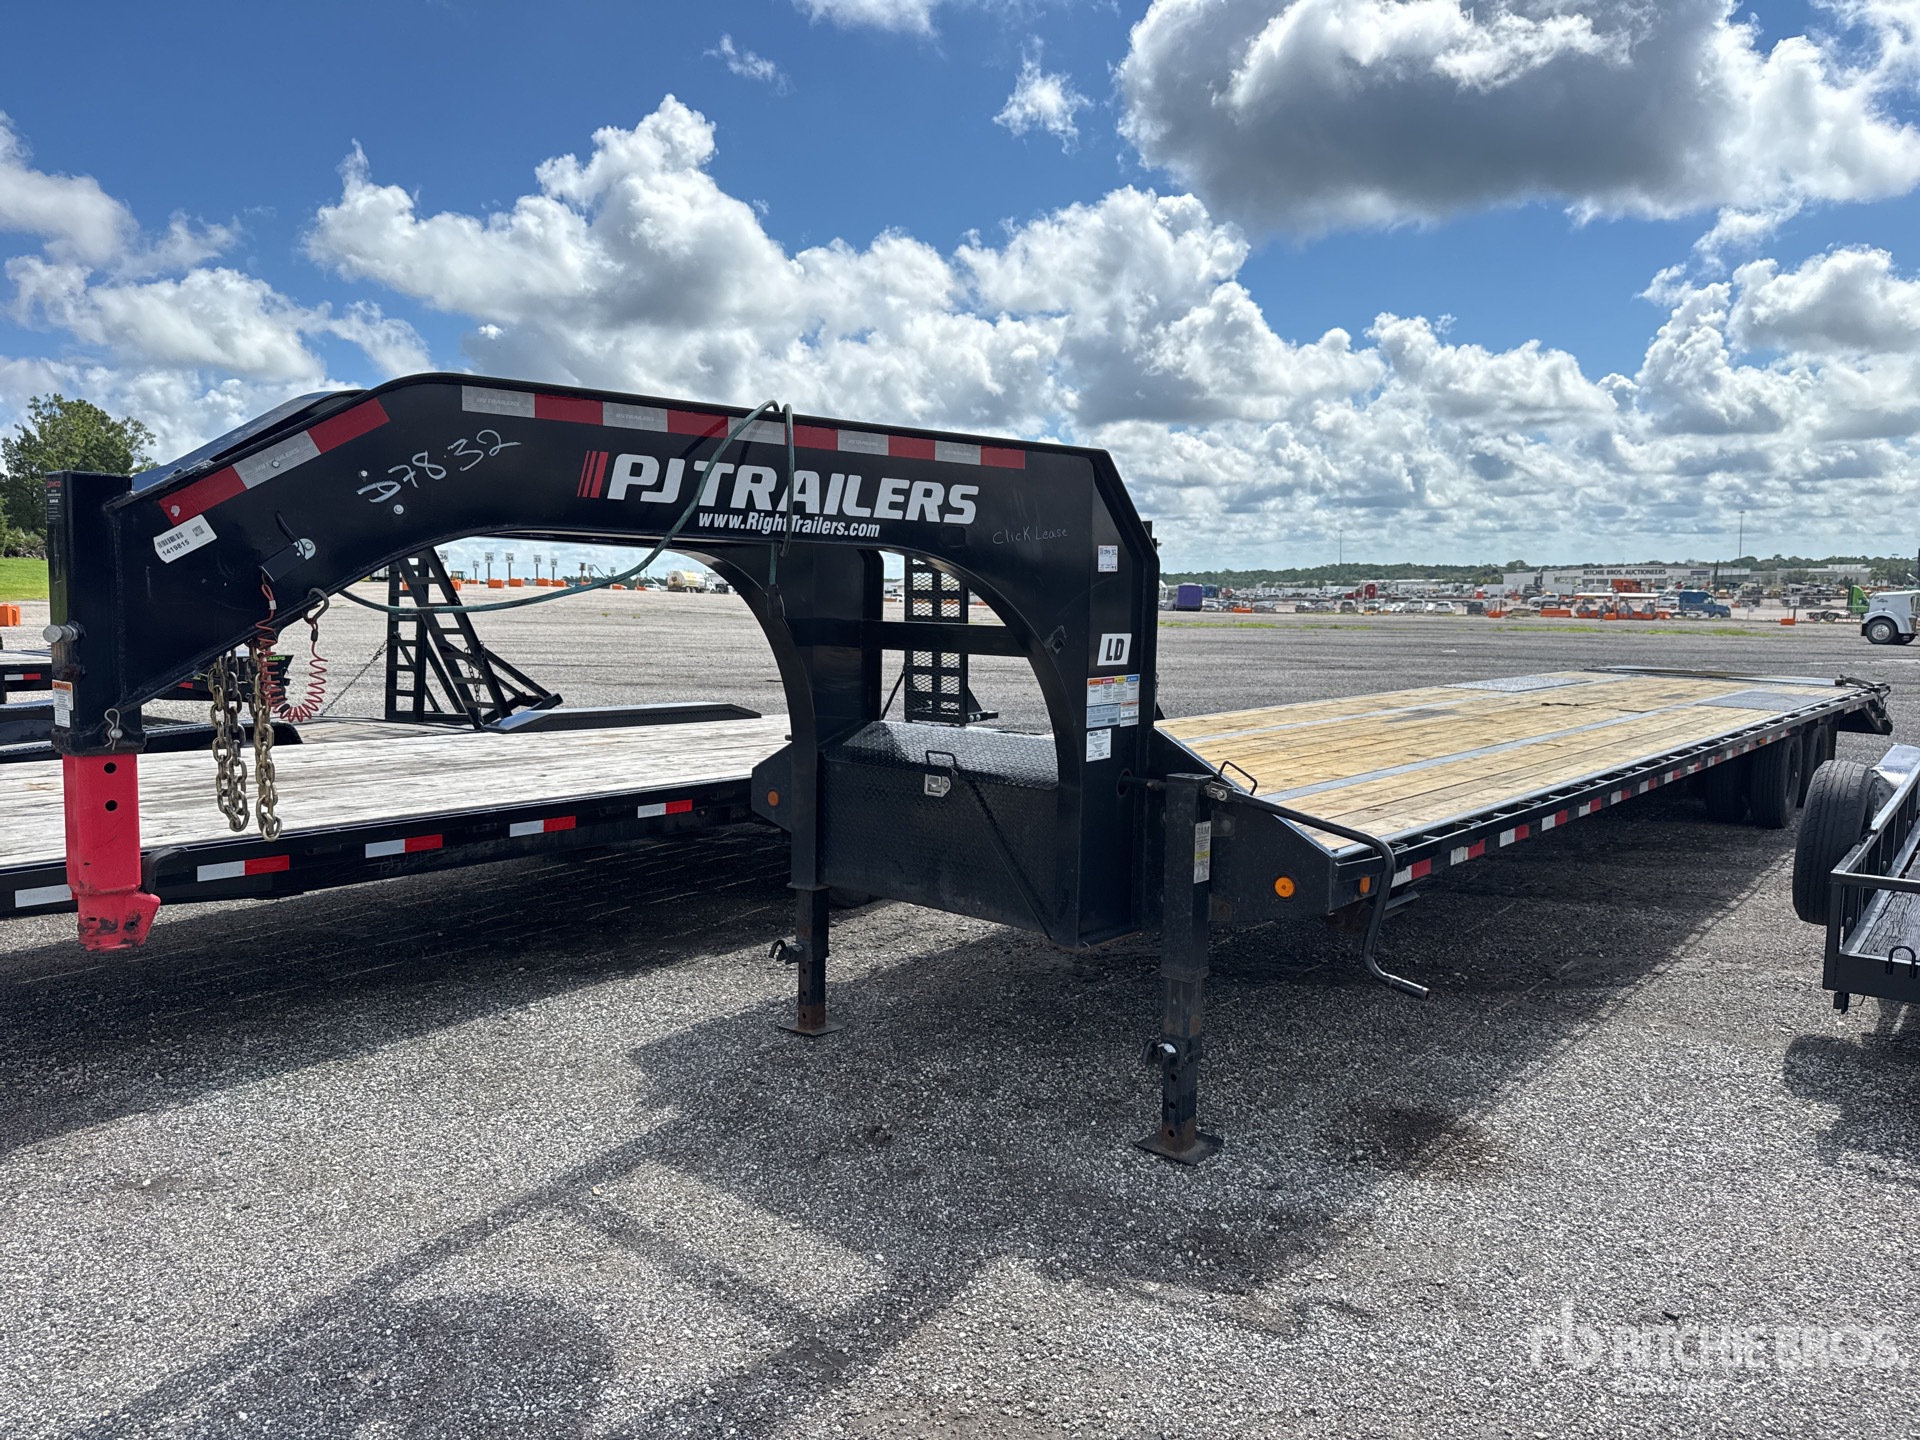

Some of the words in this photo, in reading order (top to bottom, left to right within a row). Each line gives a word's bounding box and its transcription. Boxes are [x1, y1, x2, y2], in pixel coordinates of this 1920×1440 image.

[606, 453, 686, 504] PJ
[693, 459, 979, 525] TRAILERS
[698, 510, 880, 538] www.RightTrailers.com
[1035, 525, 1069, 541] Lease
[161, 539, 190, 557] 1419815
[1625, 568, 1667, 576] AUCTIONEERS
[1105, 637, 1126, 662] LD
